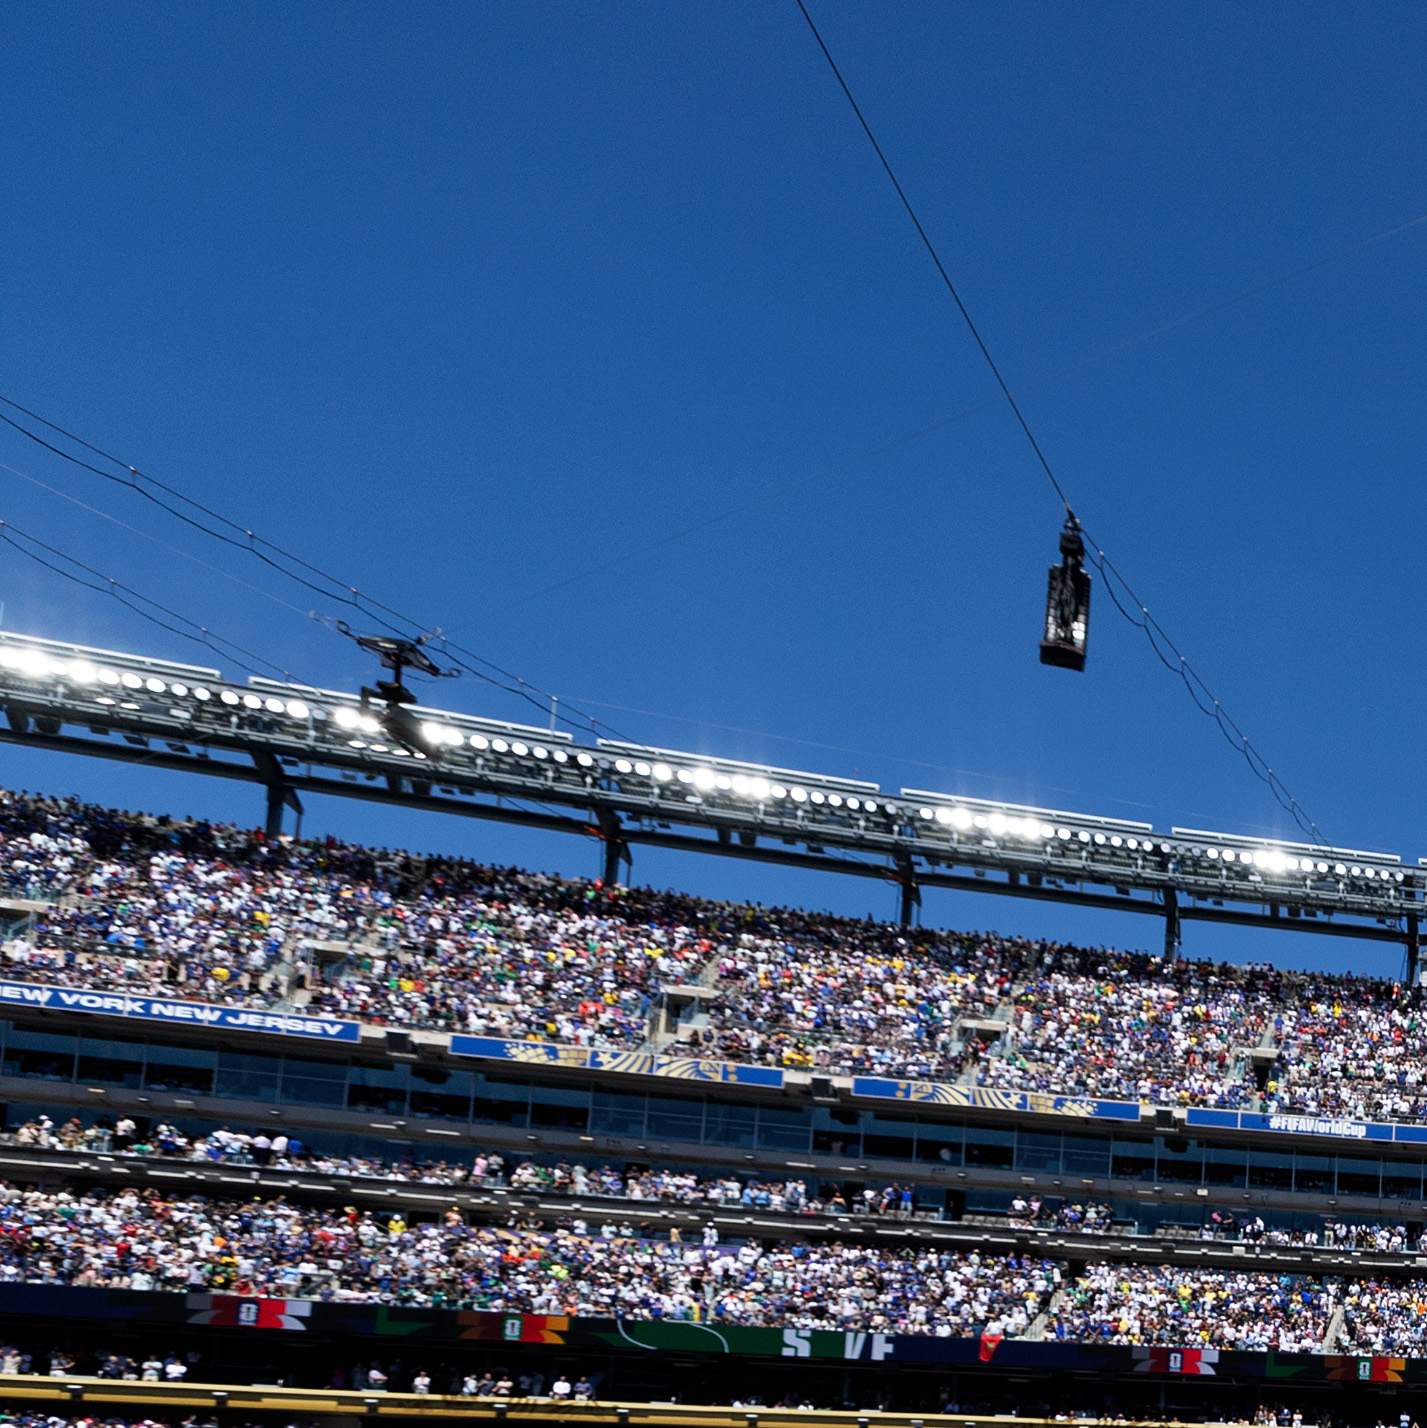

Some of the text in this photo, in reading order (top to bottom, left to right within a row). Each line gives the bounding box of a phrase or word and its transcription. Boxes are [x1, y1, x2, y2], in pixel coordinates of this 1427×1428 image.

[0, 985, 344, 1036] EW YORK NEW JERSEY
[1268, 1116, 1367, 1138] #FIFAWorldCup
